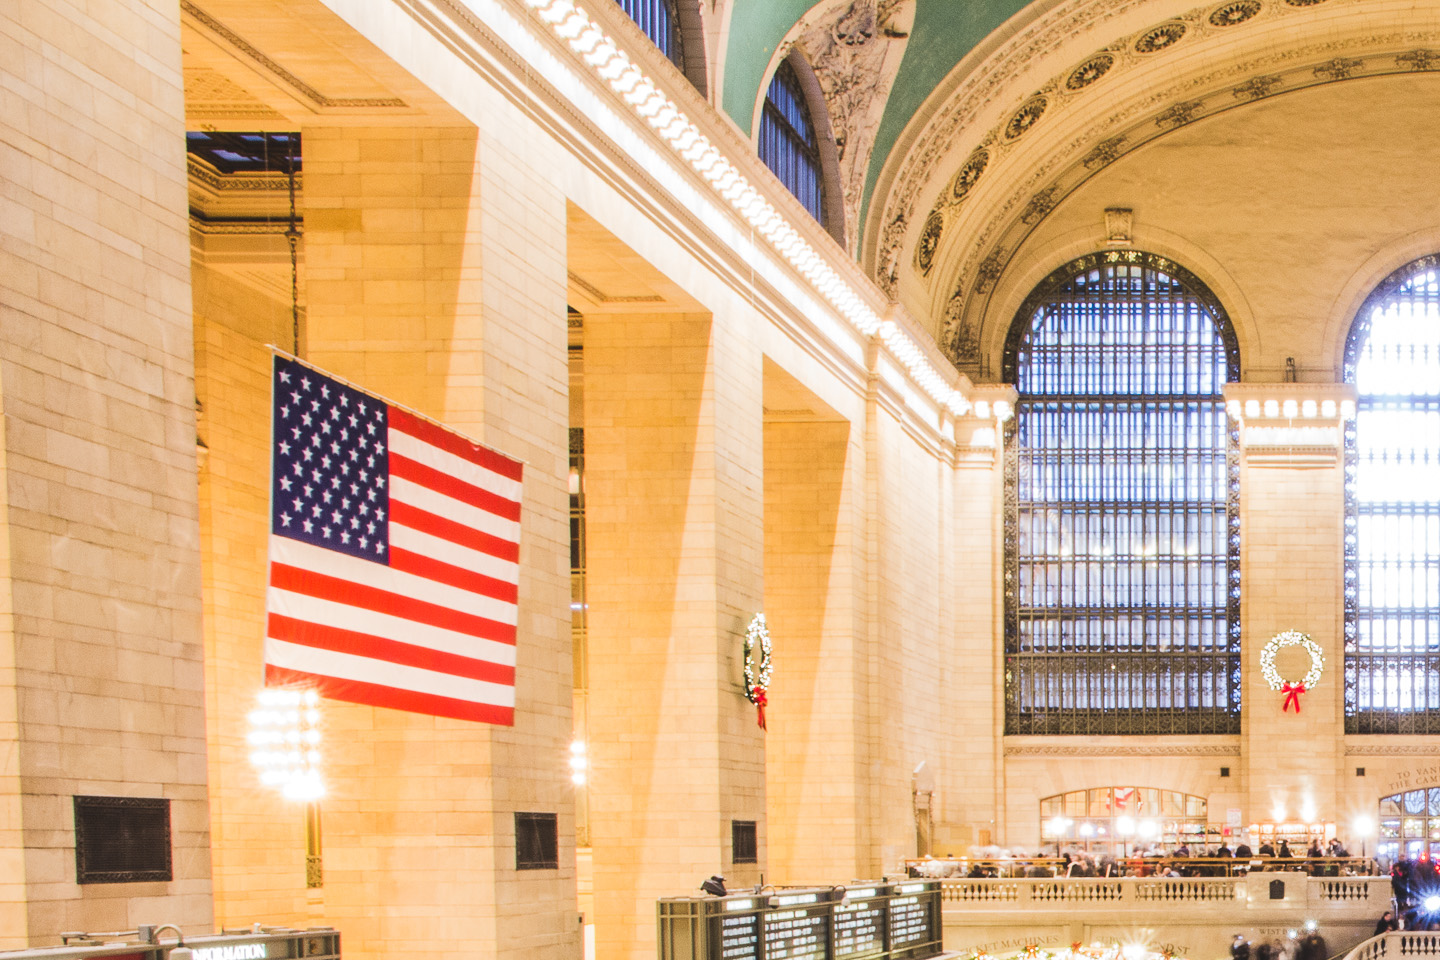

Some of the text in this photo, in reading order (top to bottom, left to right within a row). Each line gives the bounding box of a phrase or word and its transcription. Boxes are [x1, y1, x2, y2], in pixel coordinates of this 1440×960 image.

[1397, 771, 1411, 779] TO
[1389, 781, 1410, 790] THE
[1001, 935, 1060, 949] MACHINES
